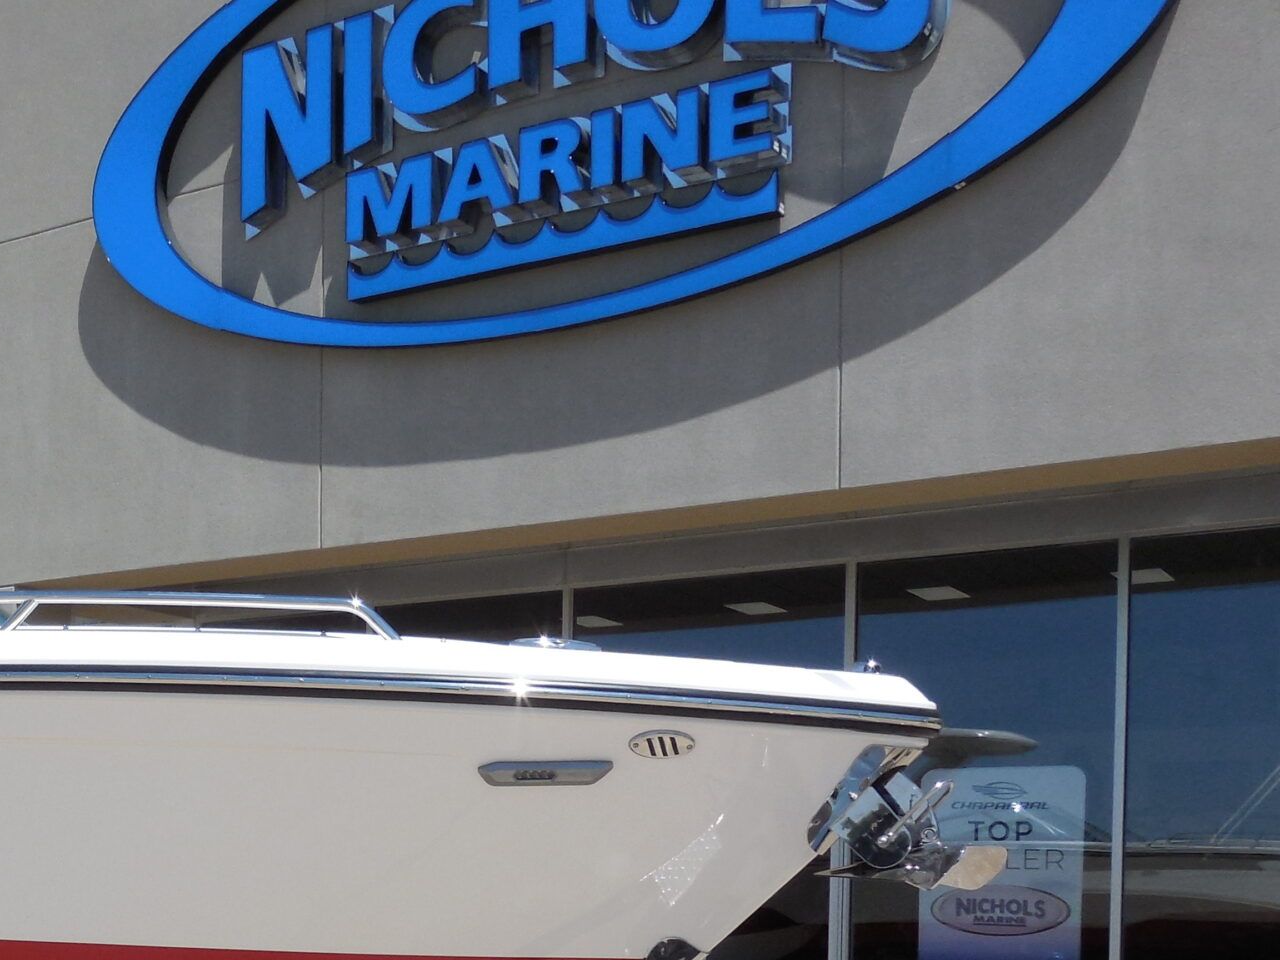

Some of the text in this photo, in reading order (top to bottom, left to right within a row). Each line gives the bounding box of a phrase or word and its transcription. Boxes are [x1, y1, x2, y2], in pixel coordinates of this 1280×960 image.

[345, 66, 776, 245] MARINE
[968, 820, 1033, 842] TOP
[1006, 848, 1065, 871] LER
[955, 897, 1046, 918] NICHOLS
[973, 915, 1027, 925] MARINE
